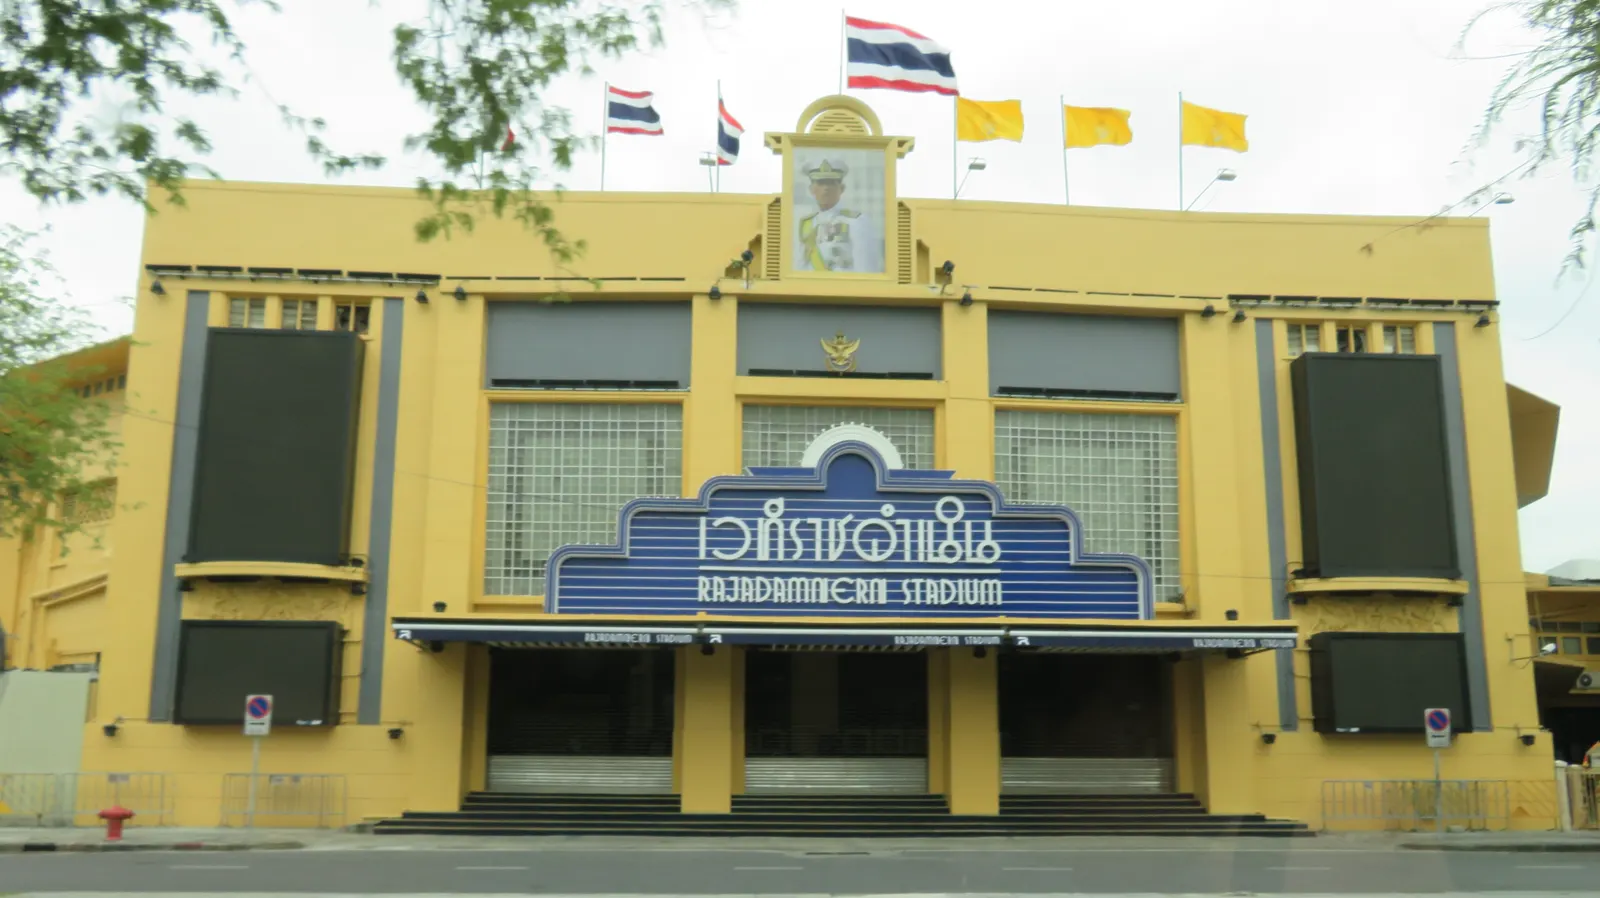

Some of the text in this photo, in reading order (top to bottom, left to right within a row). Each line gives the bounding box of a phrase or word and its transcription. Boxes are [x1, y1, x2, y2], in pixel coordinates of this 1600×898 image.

[699, 496, 1001, 564] เวทีราชดำเนิน
[698, 576, 1002, 606] RAJADAMNERN STADIUM
